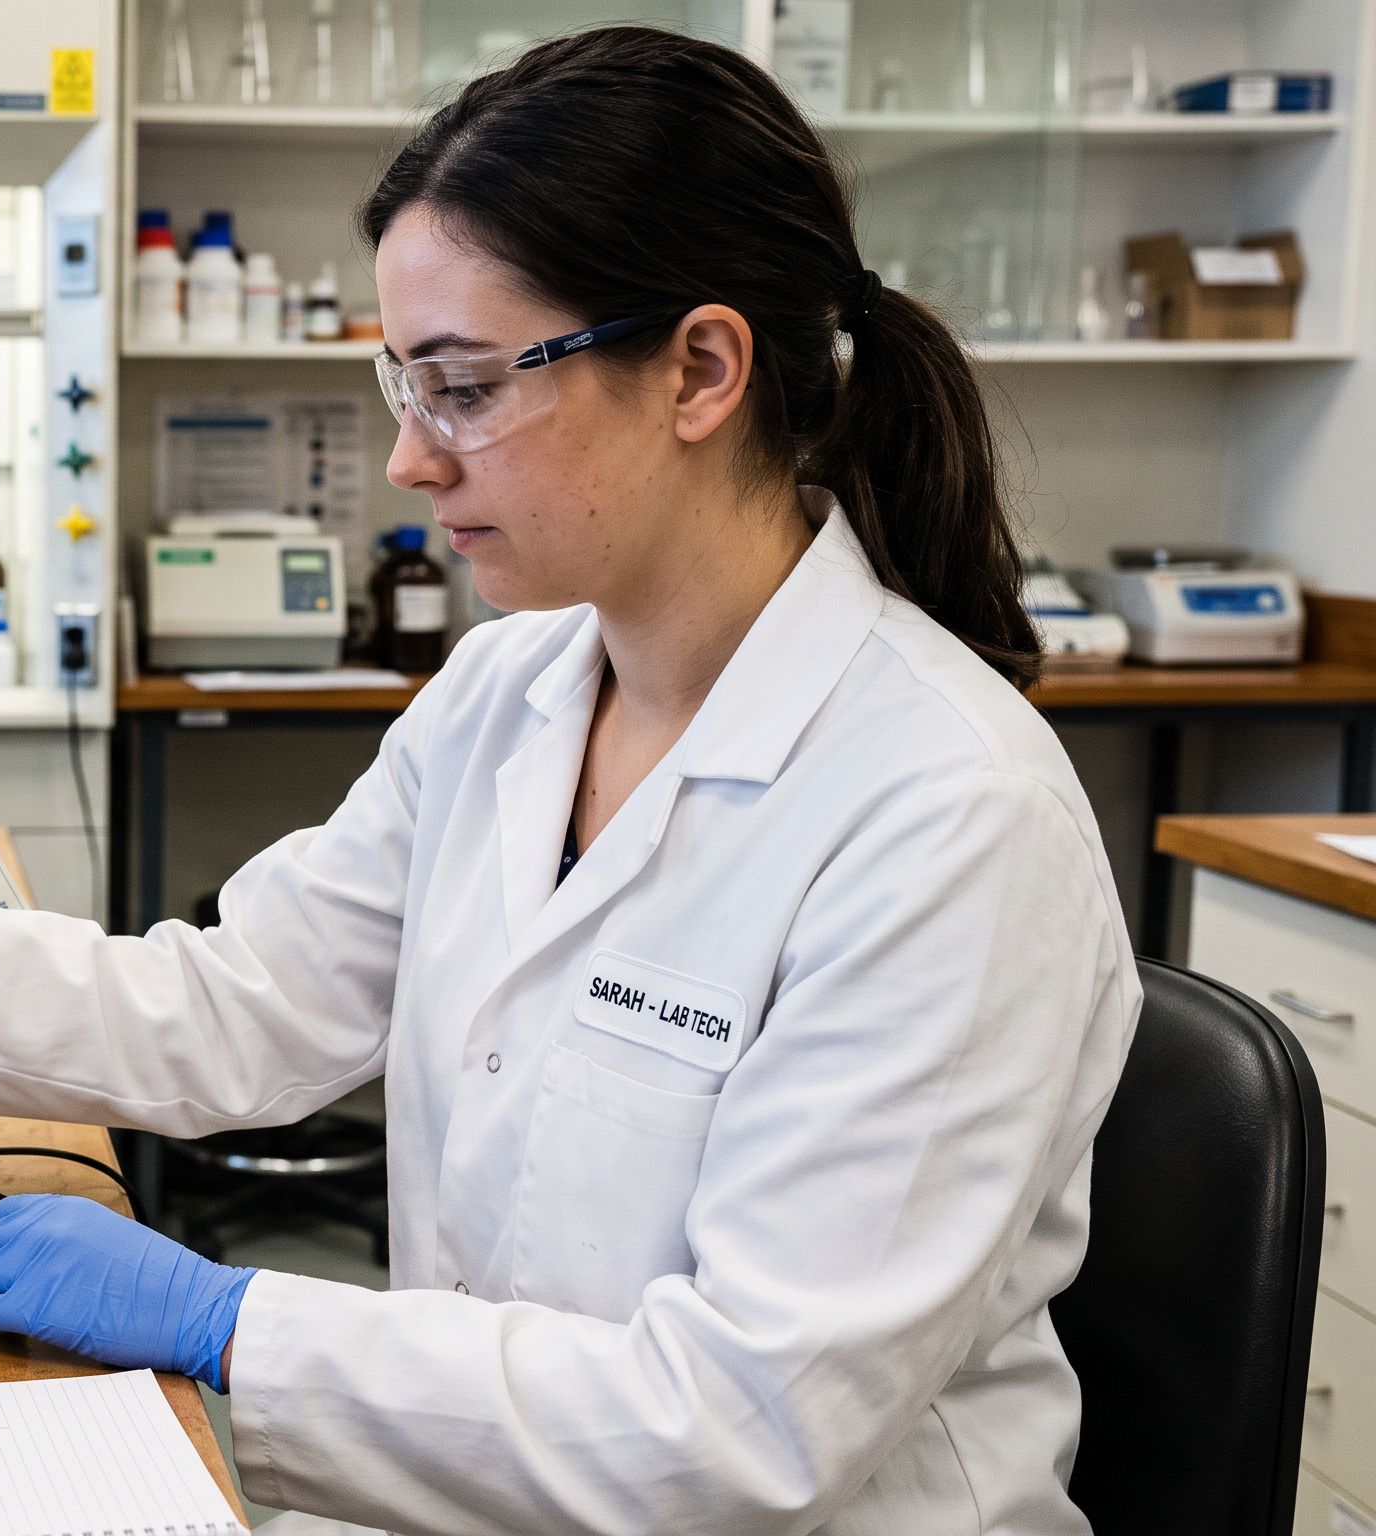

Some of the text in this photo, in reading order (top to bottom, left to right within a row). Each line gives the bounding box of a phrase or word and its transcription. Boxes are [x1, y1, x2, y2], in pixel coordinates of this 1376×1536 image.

[589, 977, 646, 1013] SARAH
[659, 1000, 690, 1028] LAB
[690, 1009, 732, 1043] TECH
